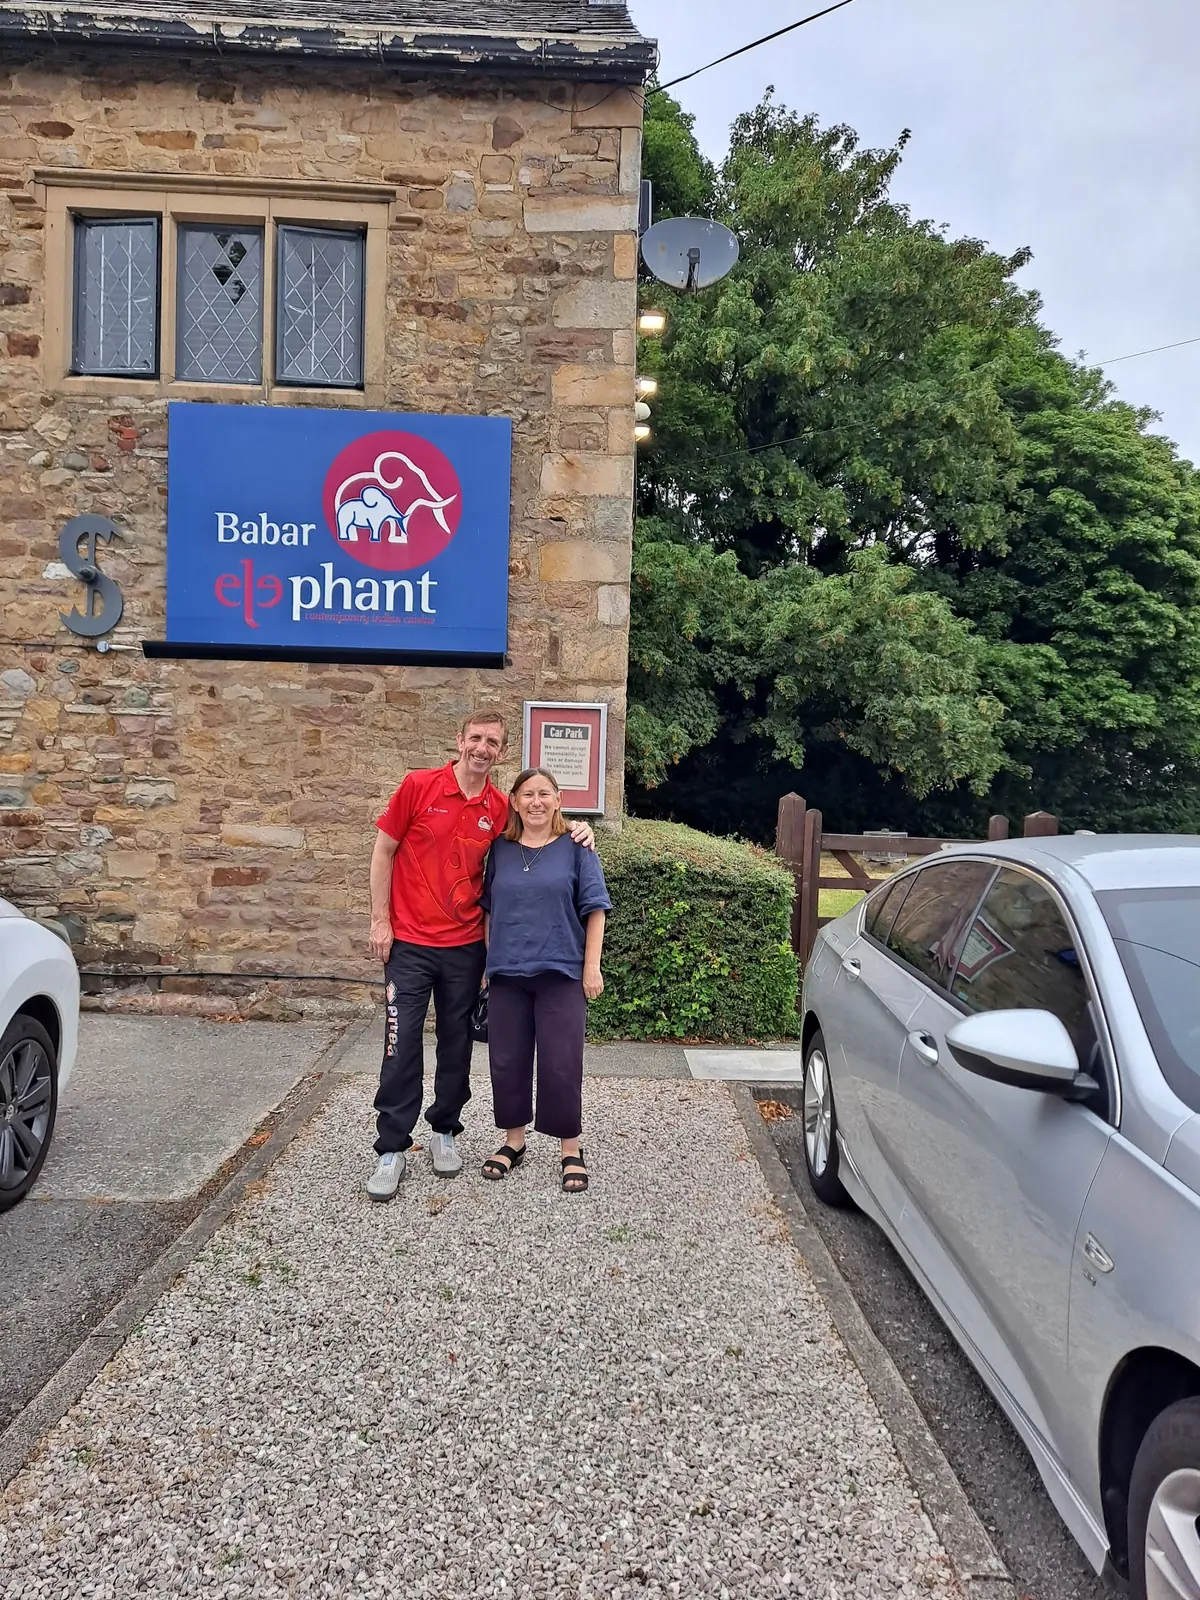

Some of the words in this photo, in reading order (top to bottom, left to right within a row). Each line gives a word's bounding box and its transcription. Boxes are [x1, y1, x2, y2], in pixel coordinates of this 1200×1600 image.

[215, 511, 316, 546] Babar
[304, 611, 370, 625] contemporary
[403, 614, 436, 625] cuisine
[550, 726, 563, 738] Car
[565, 727, 583, 738] Park
